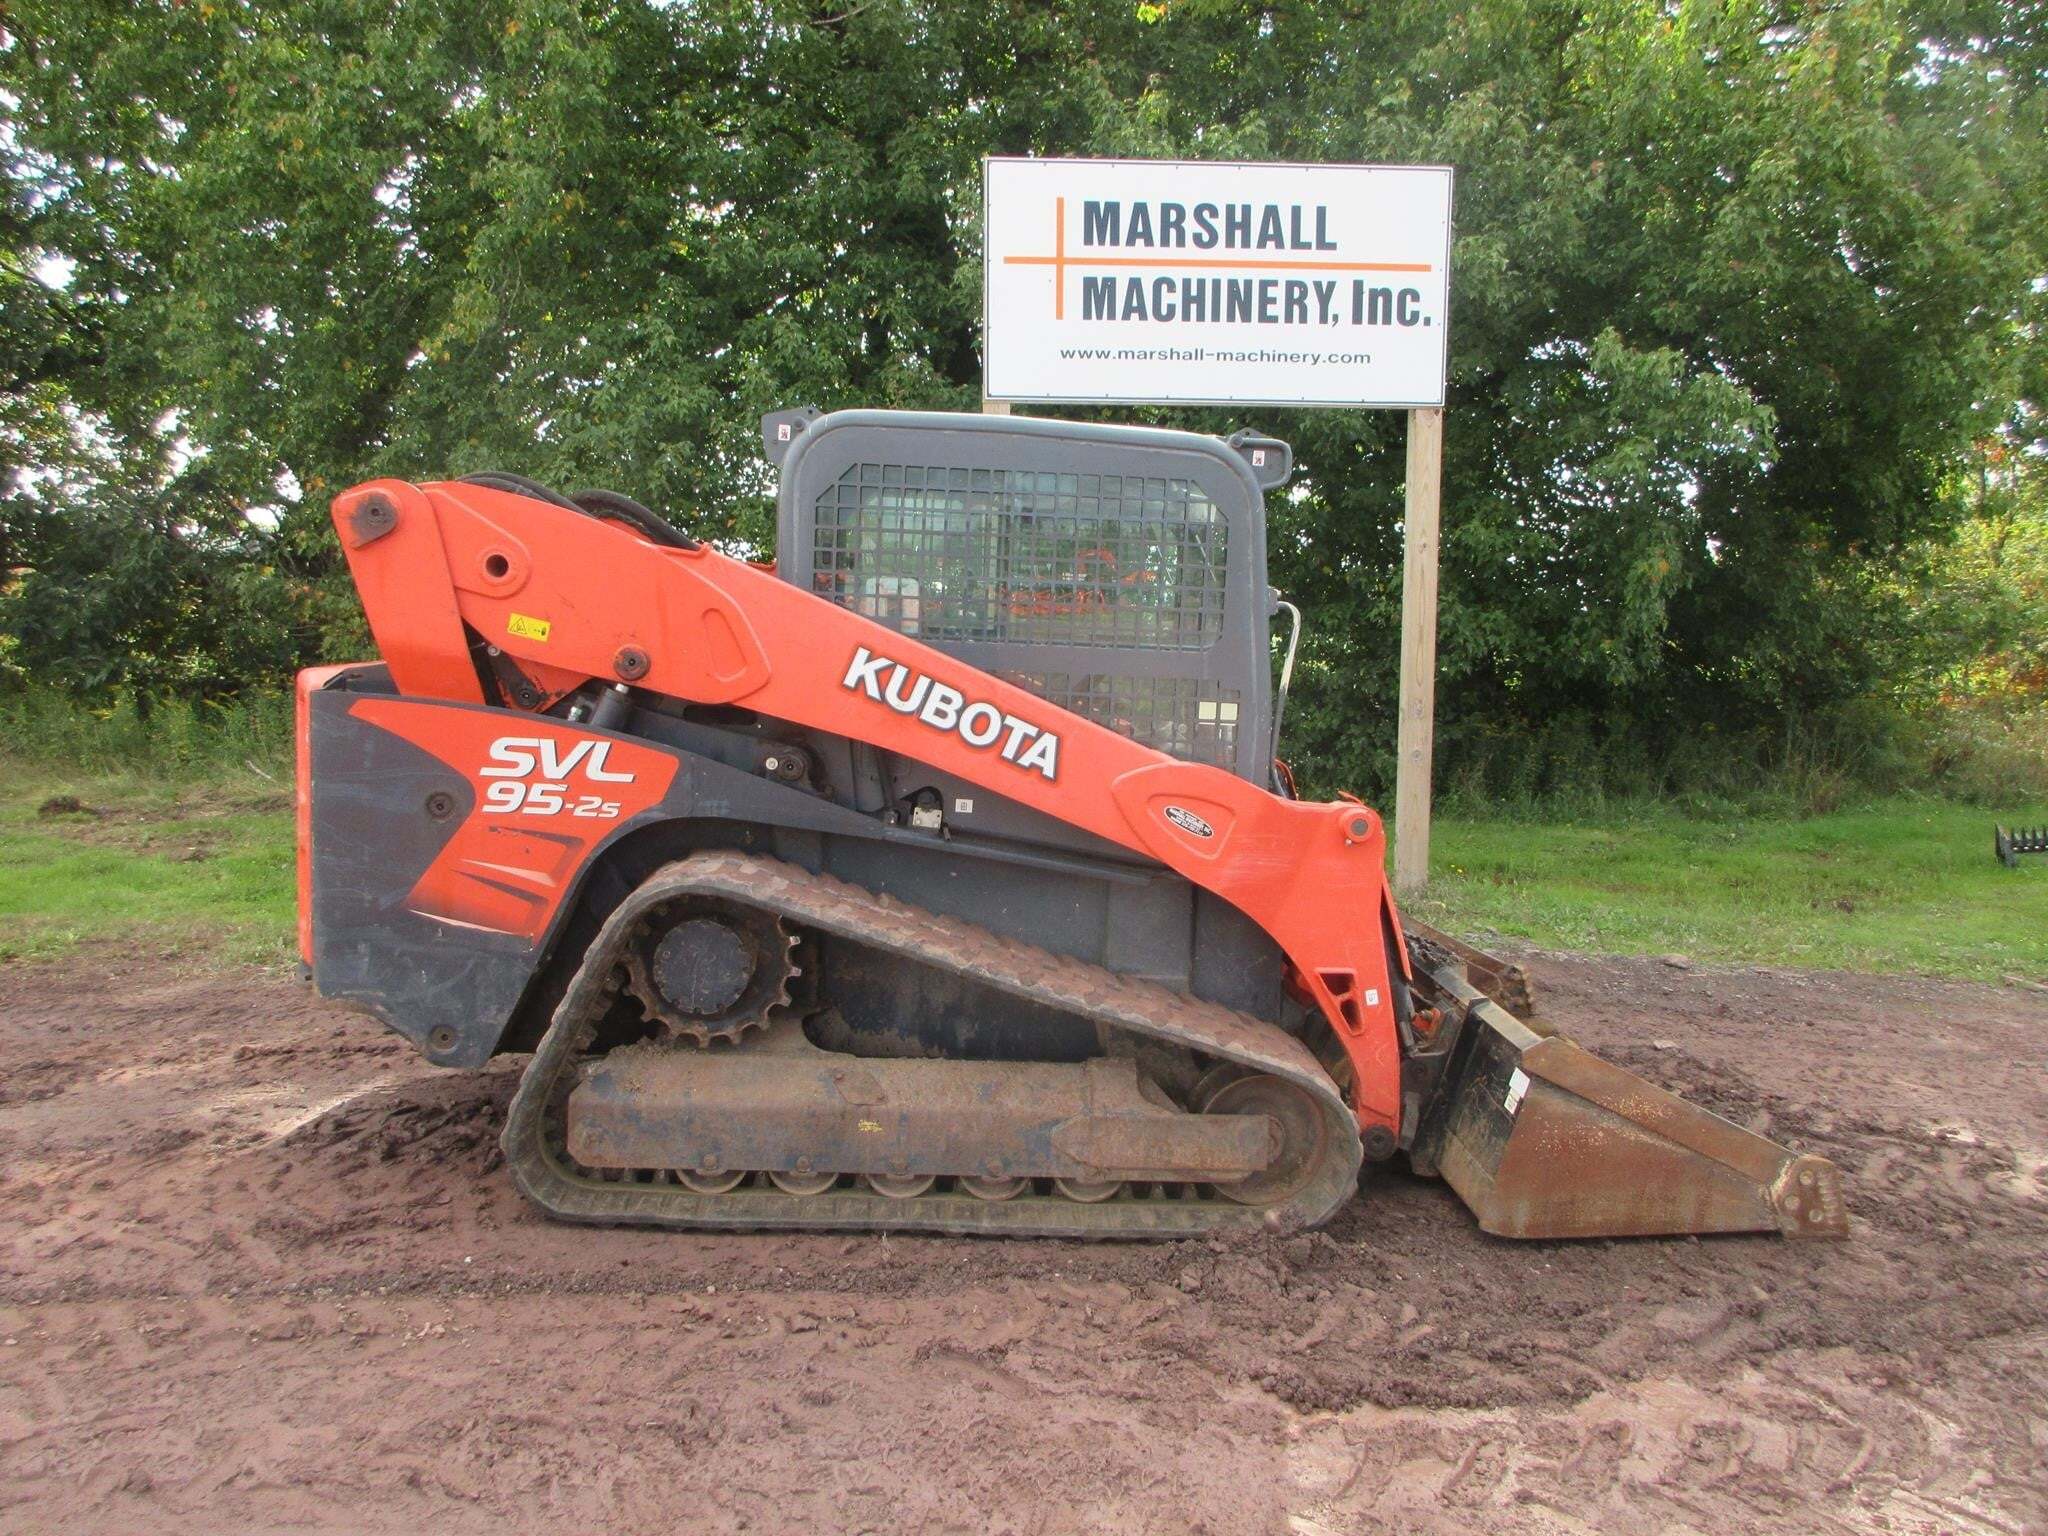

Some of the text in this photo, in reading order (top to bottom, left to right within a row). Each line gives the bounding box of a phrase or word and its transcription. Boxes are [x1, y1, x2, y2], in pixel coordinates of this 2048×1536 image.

[1082, 200, 1338, 251] MARSHALL
[1082, 276, 1432, 328] MACHINERY, Inc.
[1060, 347, 1371, 365] www.marshall-machinery.com
[843, 646, 1059, 779] KUBOTA
[480, 736, 635, 782] SVL
